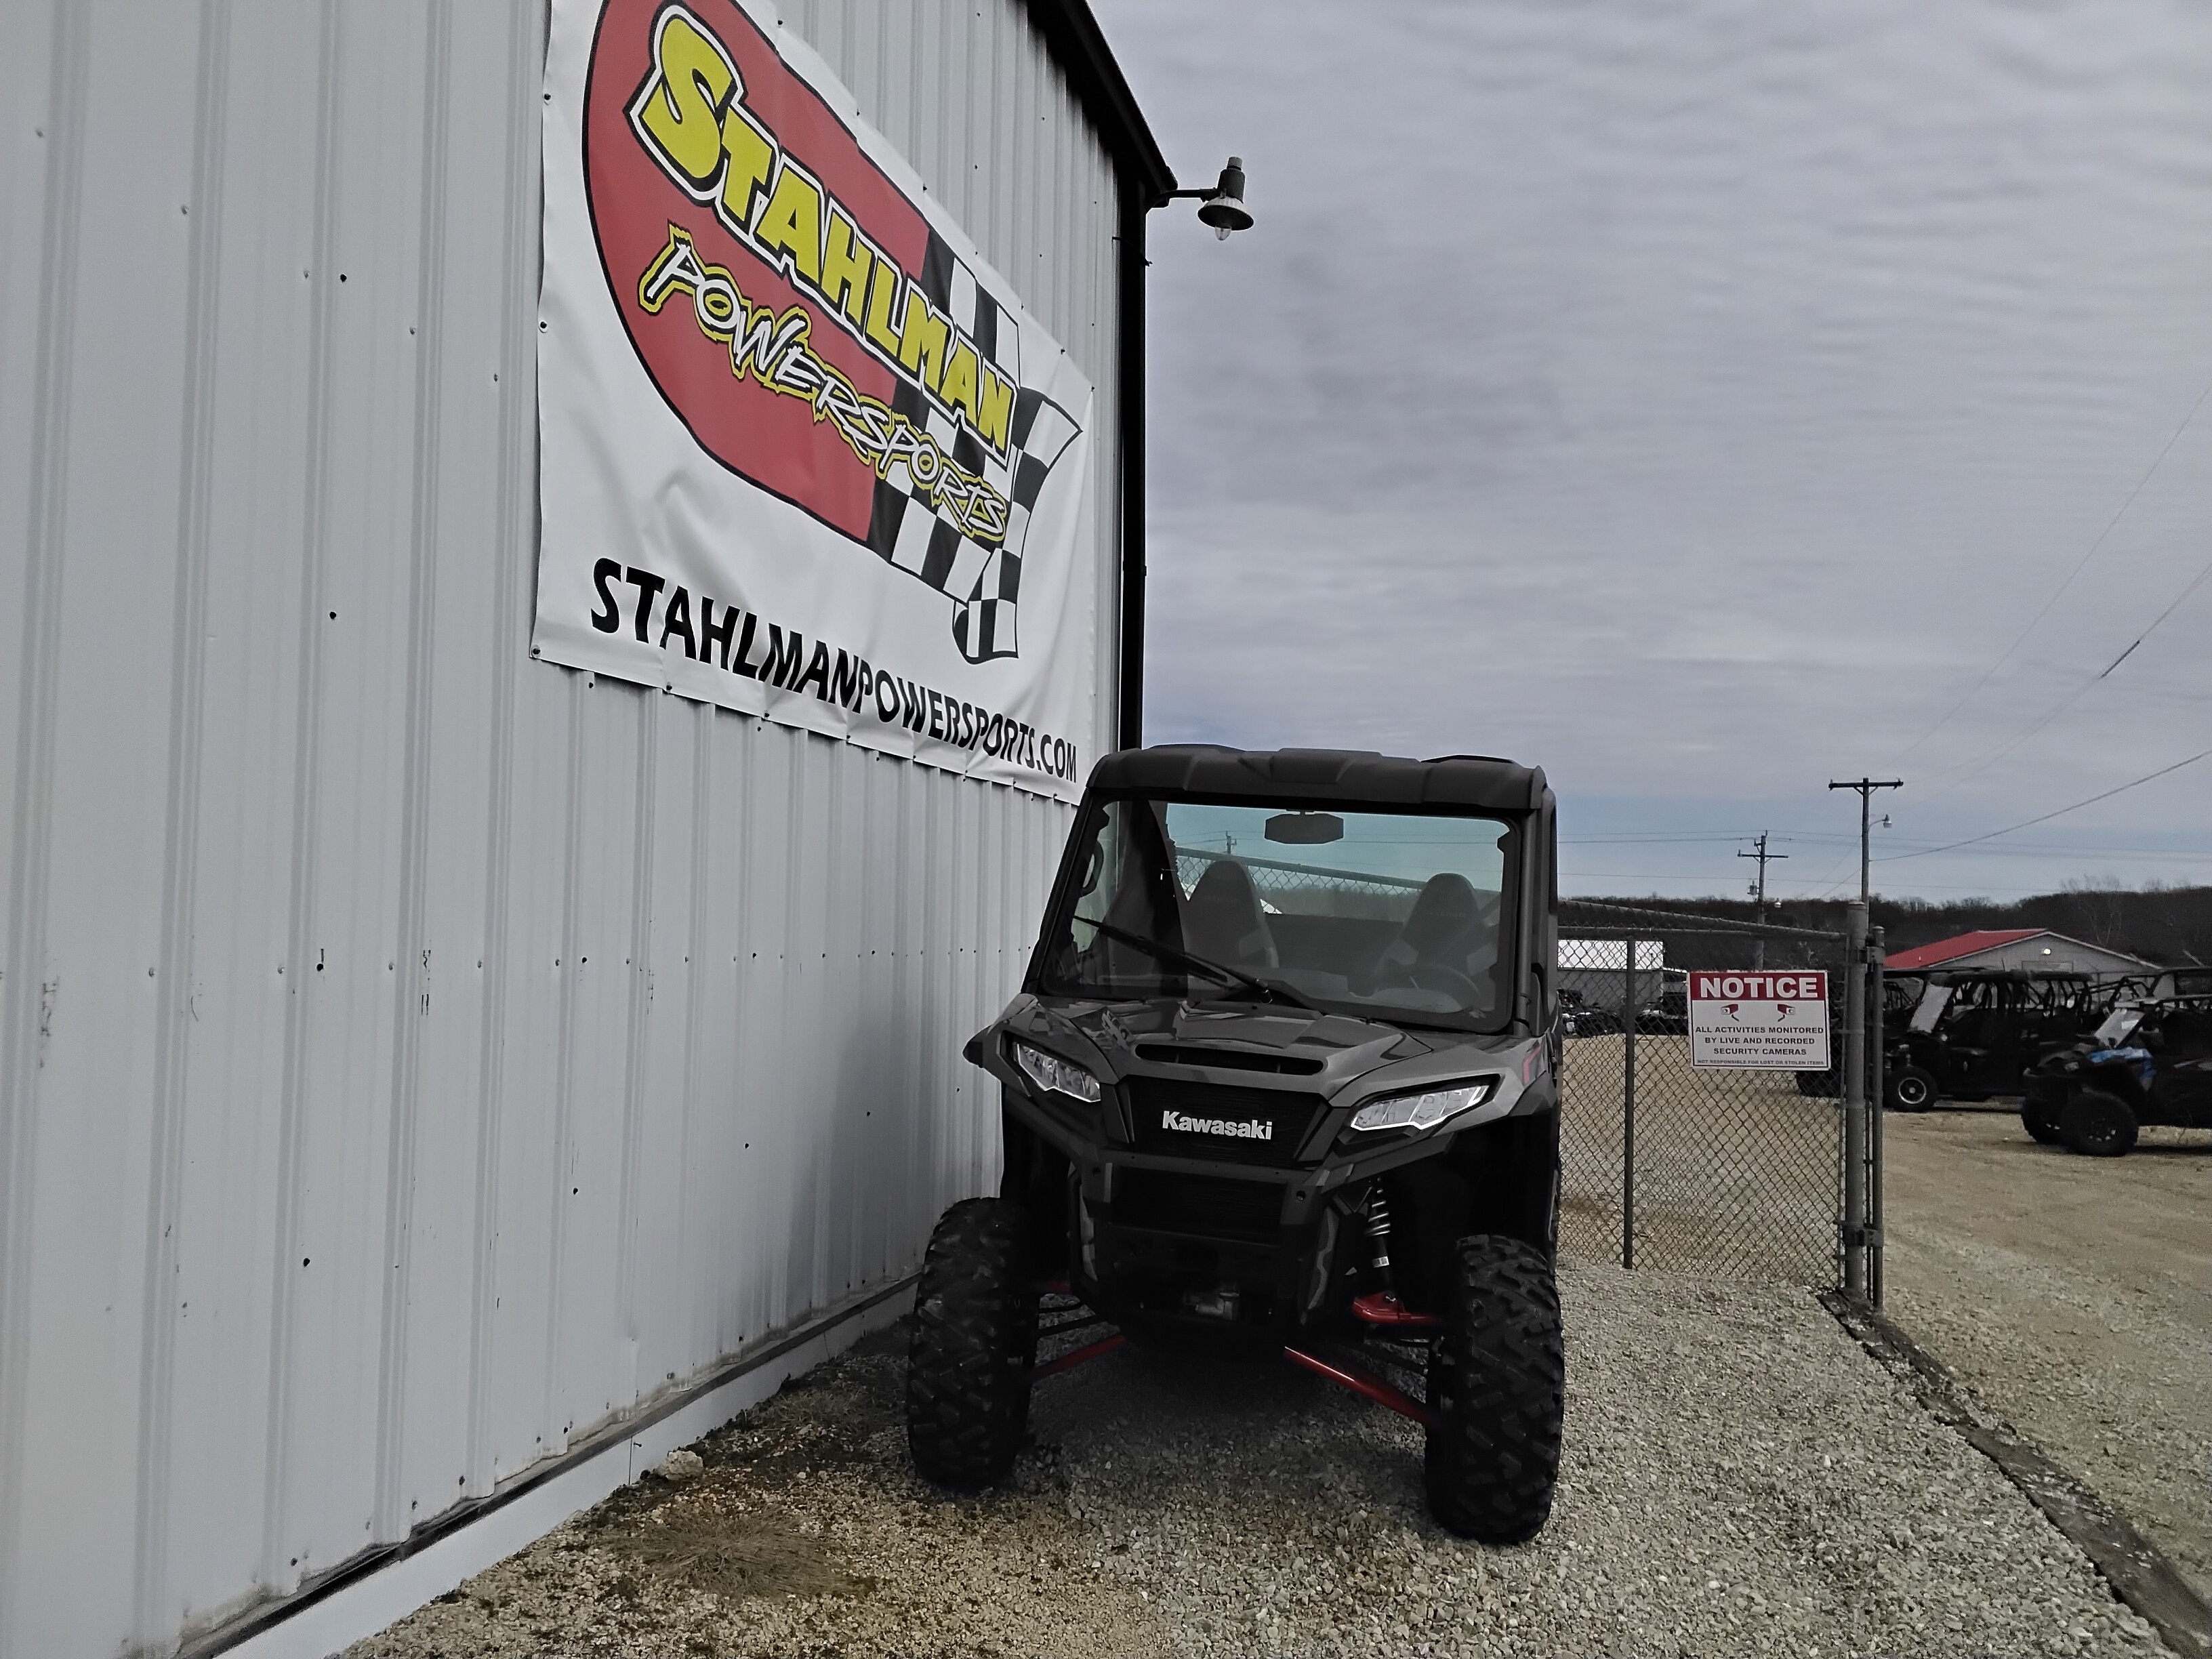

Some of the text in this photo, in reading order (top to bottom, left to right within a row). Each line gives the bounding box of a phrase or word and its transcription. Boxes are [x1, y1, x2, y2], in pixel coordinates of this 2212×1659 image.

[629, 5, 1018, 464] STAHLMAN
[640, 229, 1009, 540] POWERSPORTS
[590, 557, 1077, 783] STAHLMANPOWERSPORTS.COM
[1700, 977, 1818, 998] NOTICE
[1162, 1111, 1273, 1140] Kawasaki
